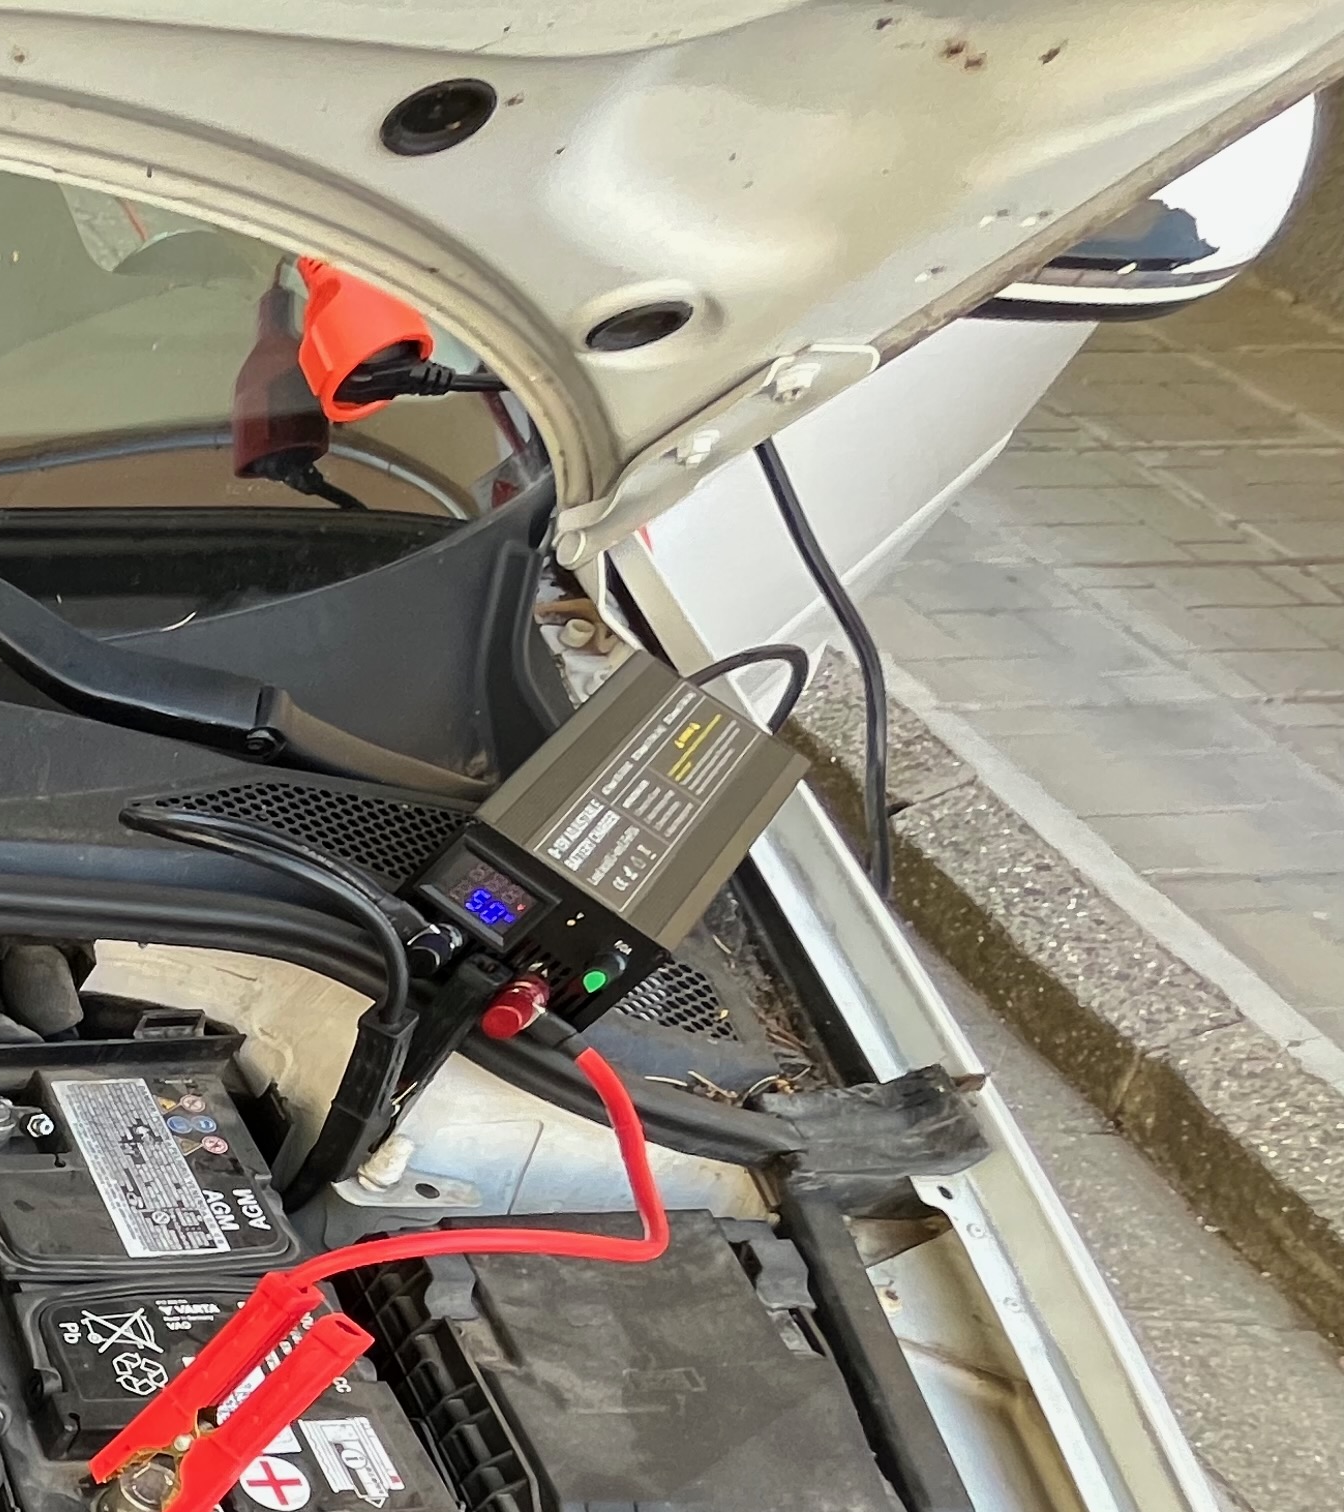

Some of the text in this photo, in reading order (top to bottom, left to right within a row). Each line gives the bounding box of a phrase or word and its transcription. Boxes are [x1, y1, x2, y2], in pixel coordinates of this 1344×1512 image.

[202, 1188, 241, 1232] AGM
[232, 1187, 272, 1231] AGM
[173, 1303, 221, 1314] VARTA
[58, 1322, 81, 1344] Pb
